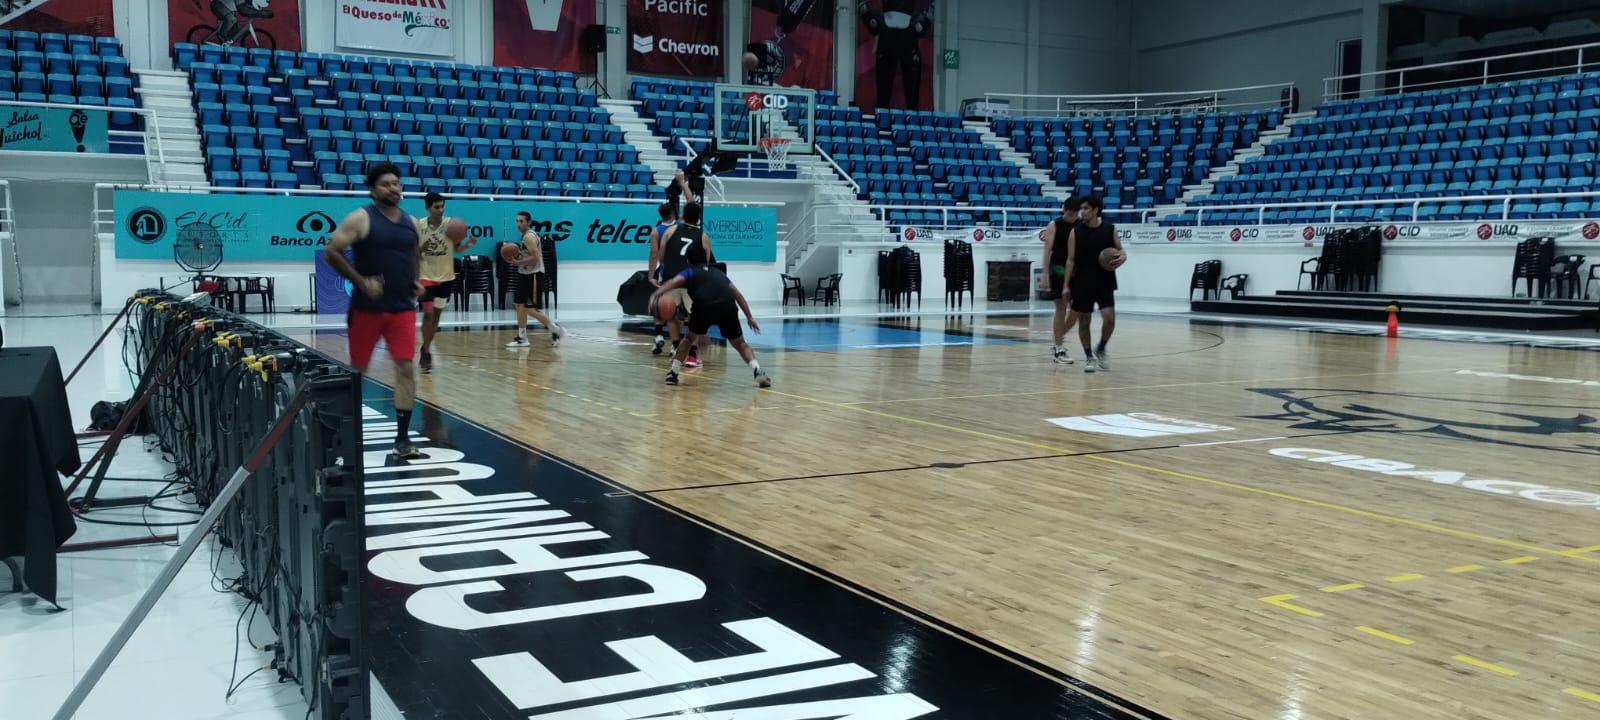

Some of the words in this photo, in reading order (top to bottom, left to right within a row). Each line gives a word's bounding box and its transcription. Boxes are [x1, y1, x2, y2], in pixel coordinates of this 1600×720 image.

[352, 7, 392, 21] Queso
[645, 0, 708, 16] Pacific
[659, 38, 719, 56] Chevron
[763, 94, 788, 109] CID
[586, 218, 652, 243] telce
[703, 220, 763, 233] NIVERSIDAD
[1242, 228, 1259, 238] CID
[1399, 225, 1421, 237] CID
[270, 235, 313, 246] Banco
[680, 237, 693, 256] 7
[1269, 447, 1600, 507] CIBACO
